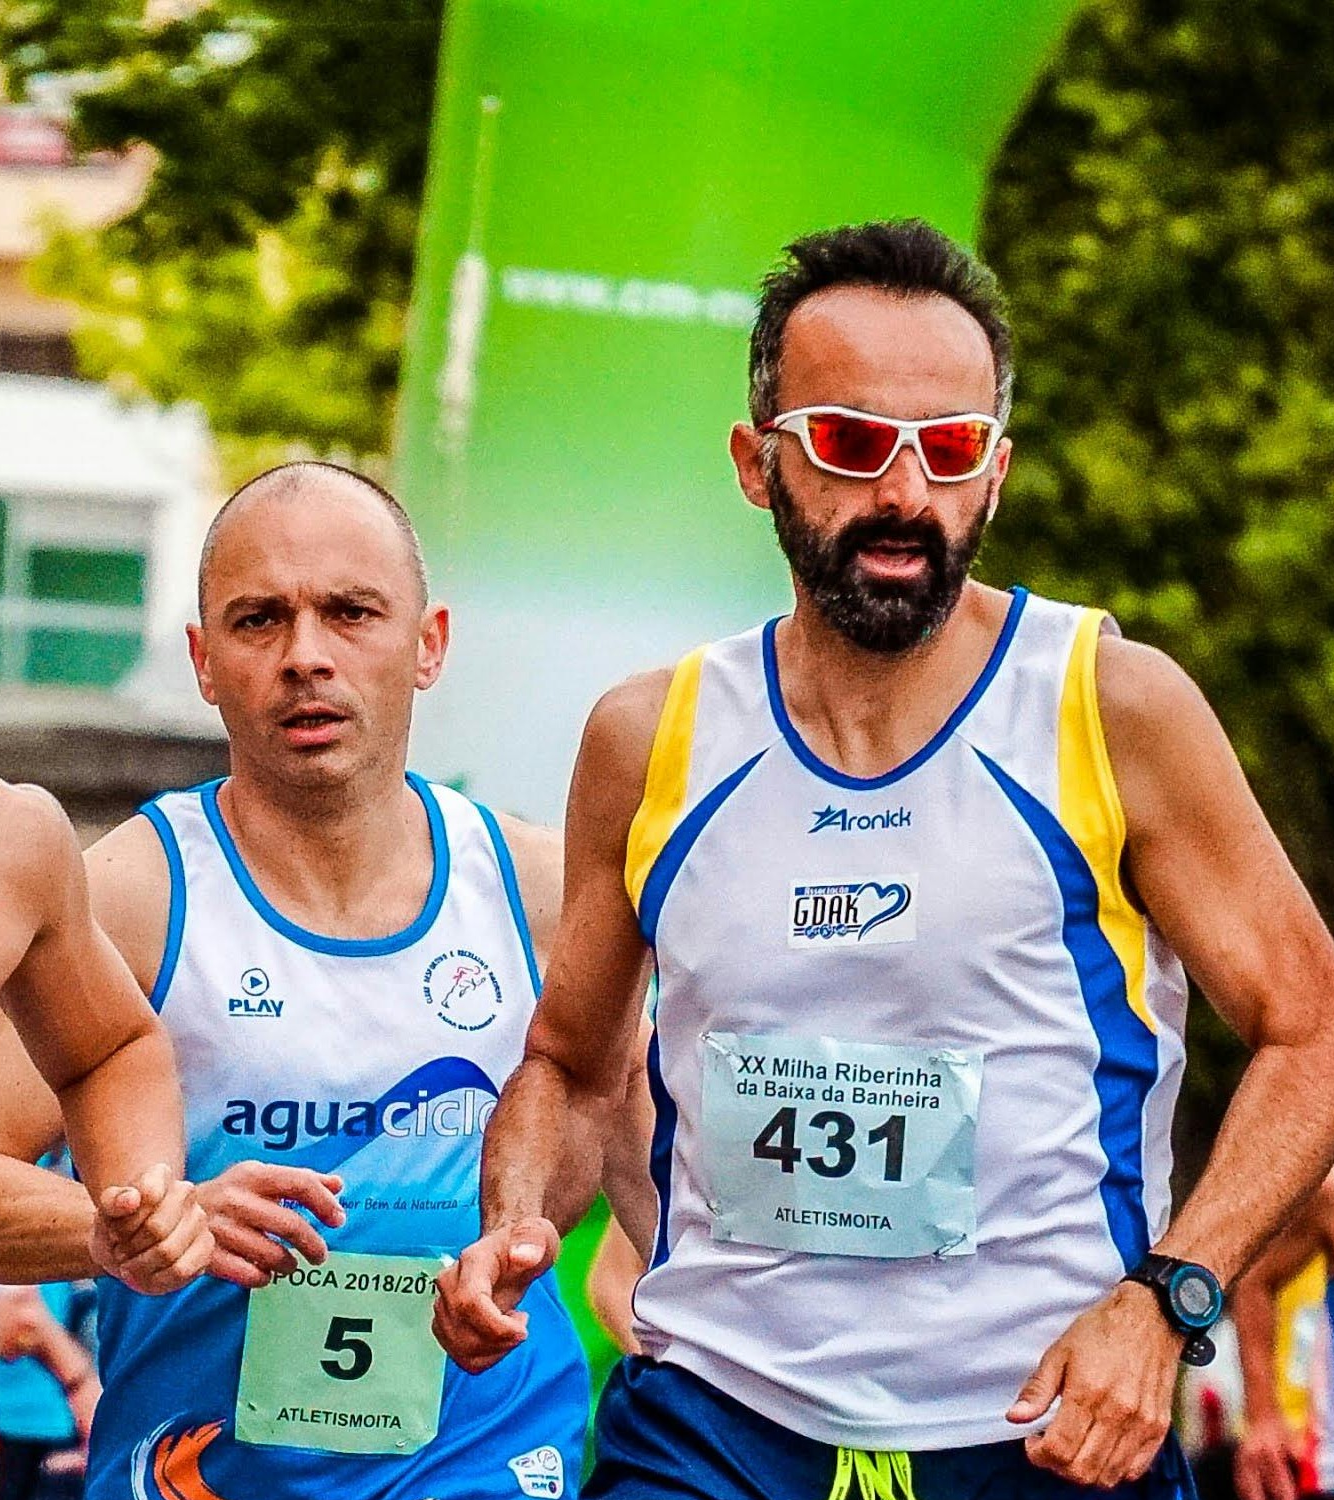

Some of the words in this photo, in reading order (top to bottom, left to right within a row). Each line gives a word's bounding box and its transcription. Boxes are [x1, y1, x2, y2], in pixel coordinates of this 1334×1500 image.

[808, 806, 911, 833] Aronick
[794, 895, 858, 926] GDAK
[229, 999, 284, 1017] PLAY
[737, 1055, 766, 1075] XX
[772, 1058, 827, 1080] Milha
[835, 1063, 942, 1088] Riberinha
[737, 1079, 757, 1095] da
[764, 1080, 815, 1100] Baixa
[822, 1085, 844, 1102] da
[852, 1087, 940, 1109] Banheira
[753, 1106, 906, 1182] 431
[364, 1198, 389, 1210] Bem
[394, 1197, 407, 1210] da
[411, 1199, 458, 1211] Natureza
[774, 1207, 892, 1231] ATLETISMOITA
[272, 1268, 338, 1288] POCA
[344, 1273, 436, 1294] 2018/201
[320, 1316, 373, 1381] 5
[276, 1407, 402, 1429] ATLETISMOITA
